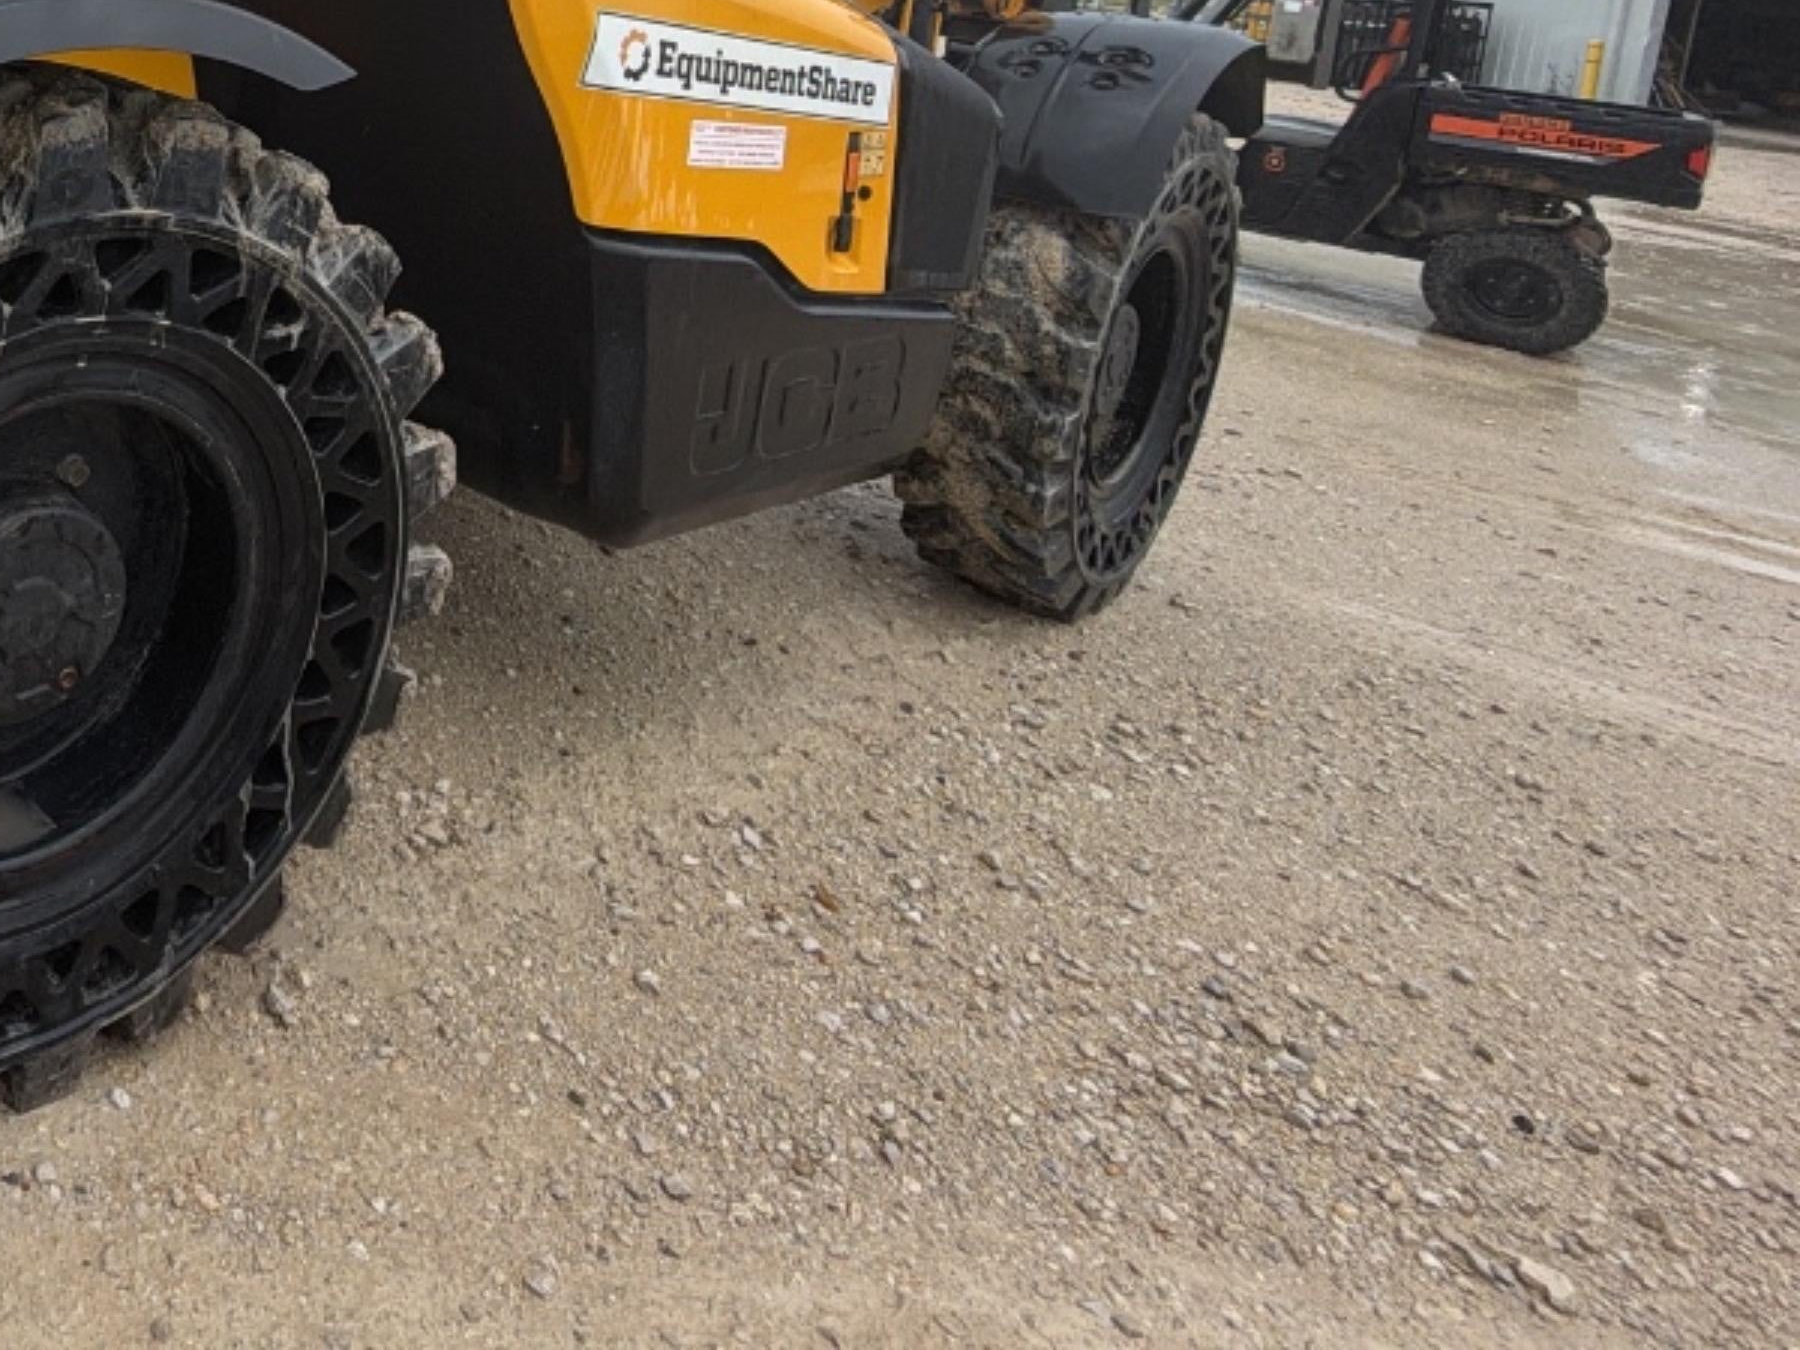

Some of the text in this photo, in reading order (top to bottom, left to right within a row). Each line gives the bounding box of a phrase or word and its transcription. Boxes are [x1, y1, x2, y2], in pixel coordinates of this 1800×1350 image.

[656, 40, 877, 107] EquipmentShare
[1498, 127, 1625, 154] POLARIS
[690, 335, 906, 475] JCB
